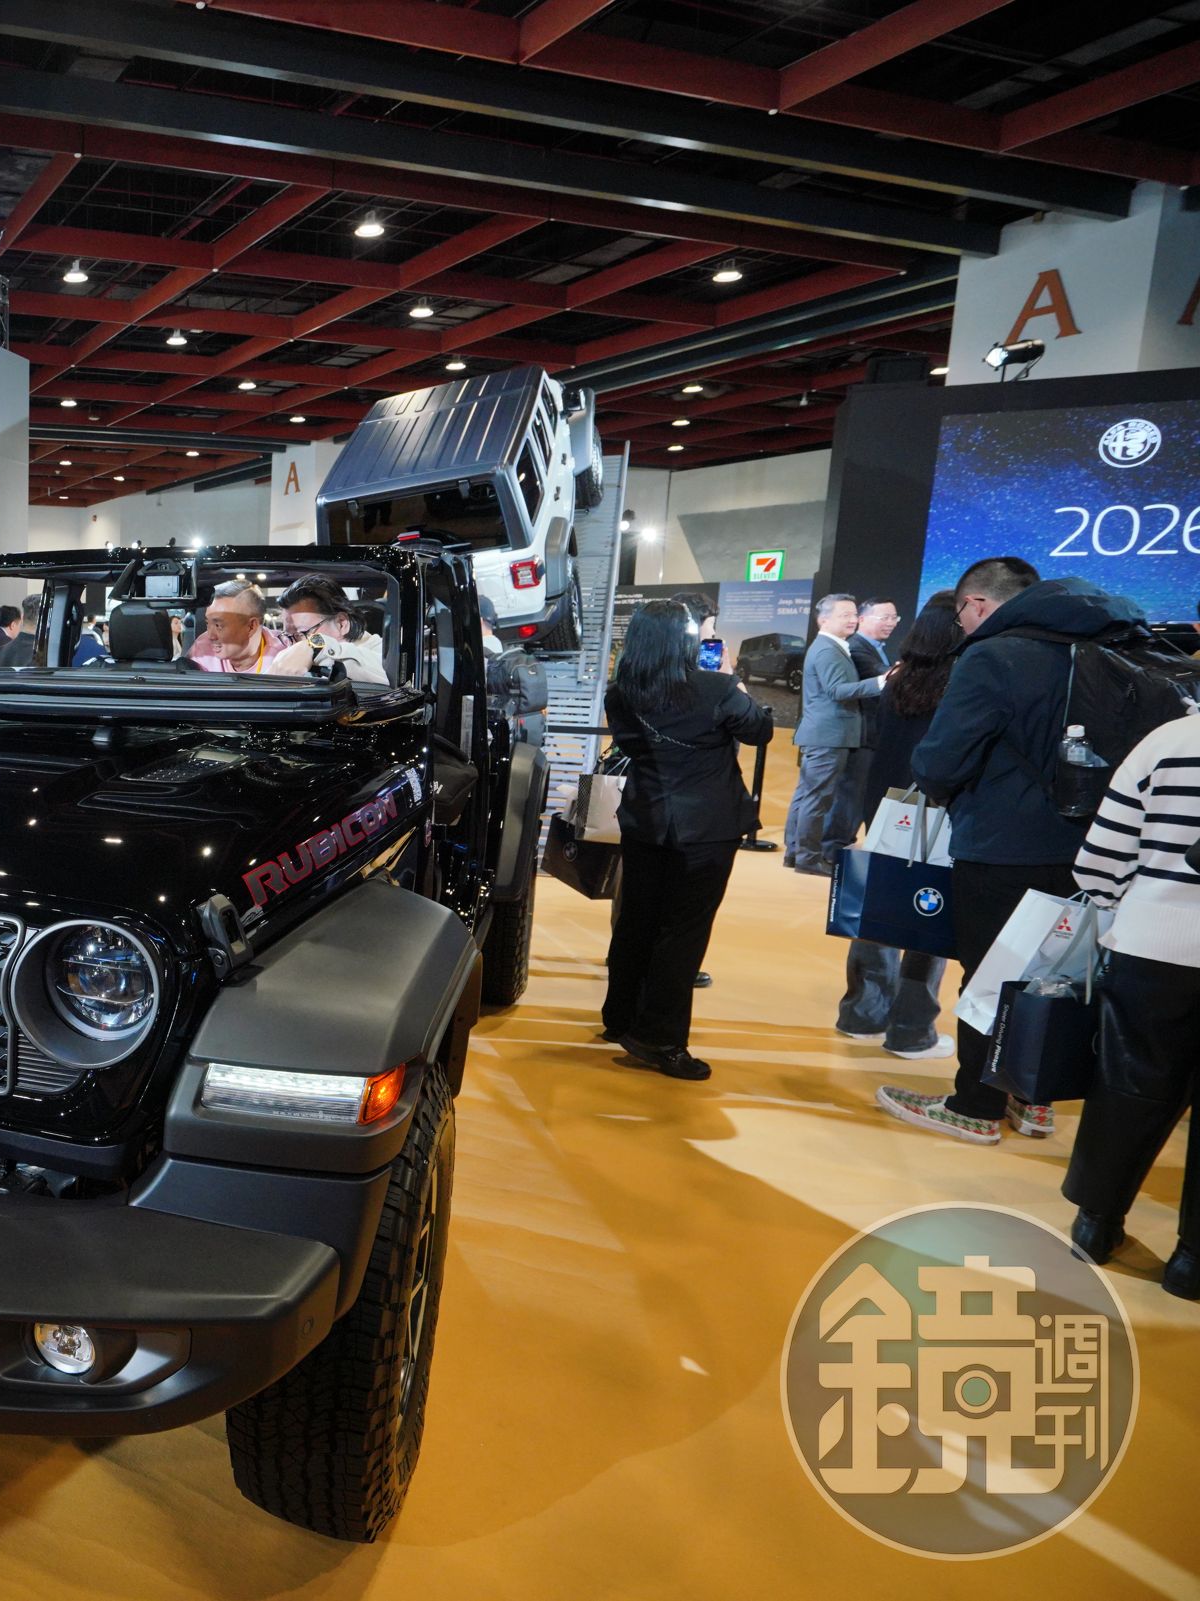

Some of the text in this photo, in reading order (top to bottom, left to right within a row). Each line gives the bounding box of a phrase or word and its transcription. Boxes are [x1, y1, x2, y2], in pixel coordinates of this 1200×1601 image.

[1004, 268, 1082, 346] A
[284, 461, 301, 496] A
[756, 557, 776, 573] 7
[242, 793, 399, 907] RUBICON
[991, 1045, 1002, 1073] Pleasure
